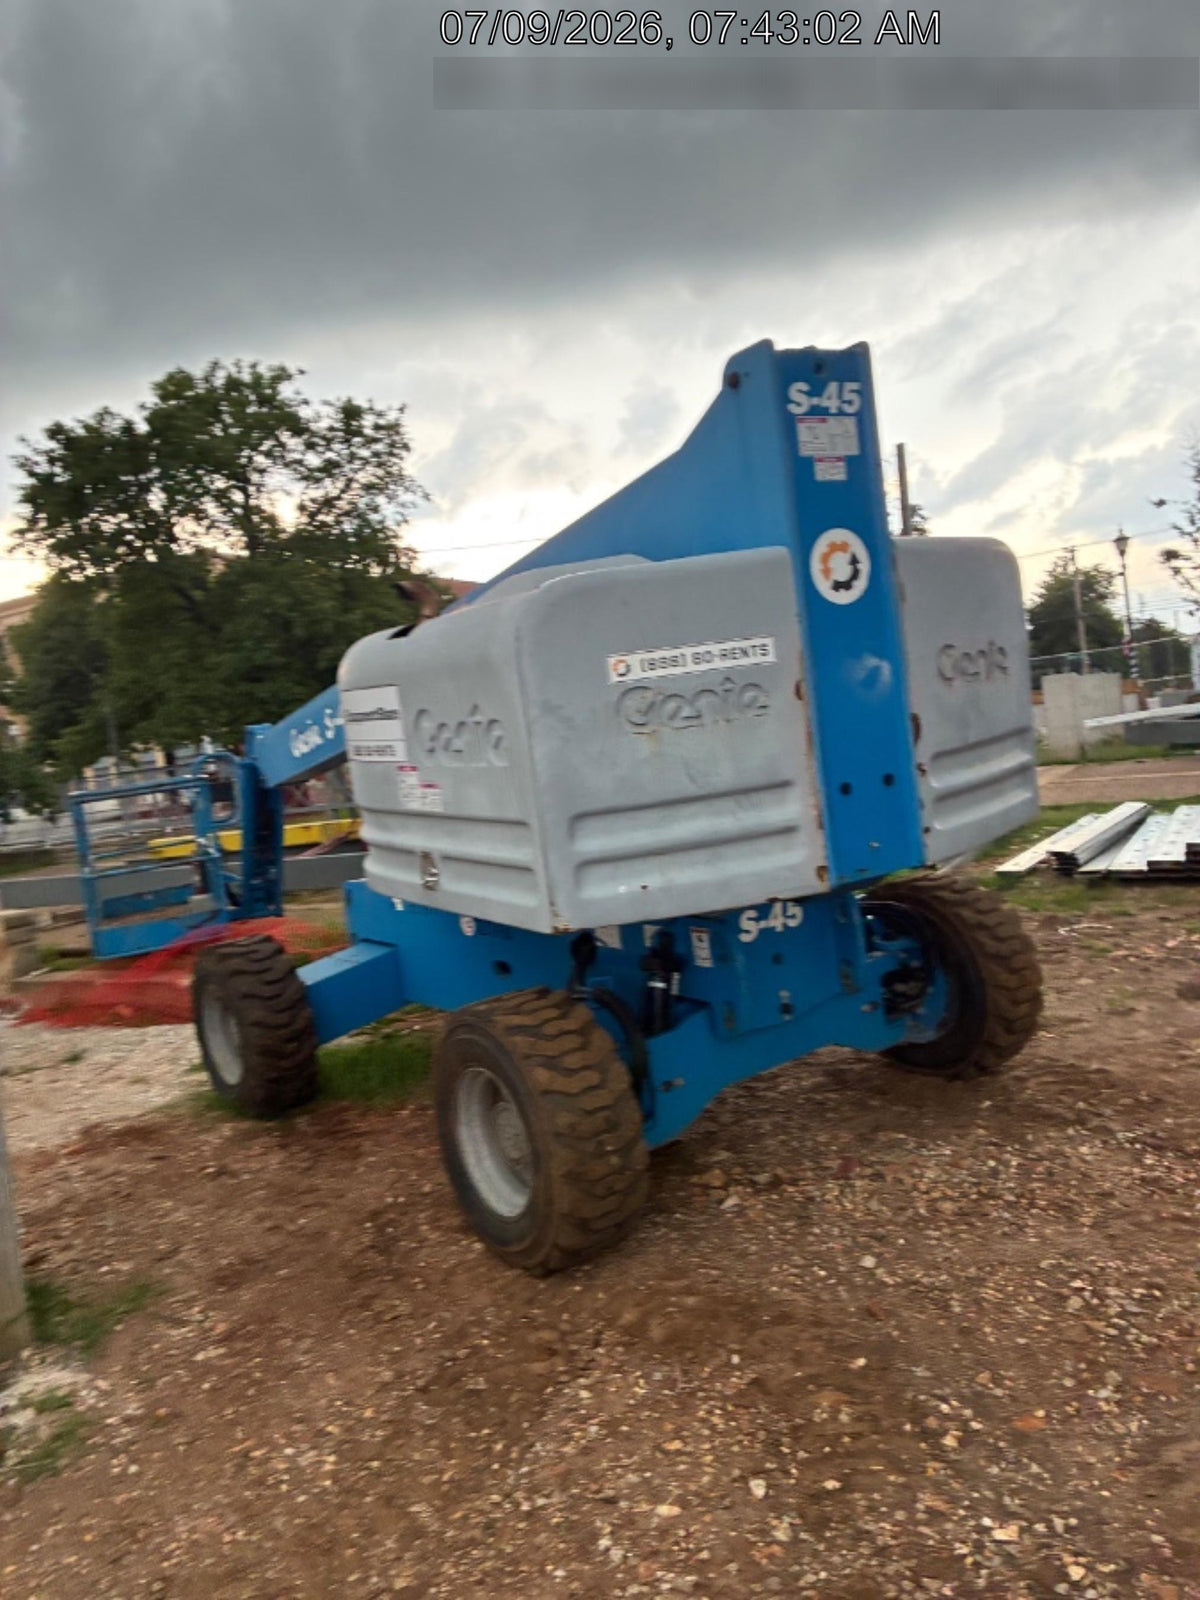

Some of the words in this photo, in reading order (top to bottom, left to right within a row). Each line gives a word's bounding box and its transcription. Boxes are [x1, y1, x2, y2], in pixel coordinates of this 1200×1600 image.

[786, 380, 863, 416] S-45
[616, 676, 771, 735] Genie
[736, 901, 805, 944] S-45
